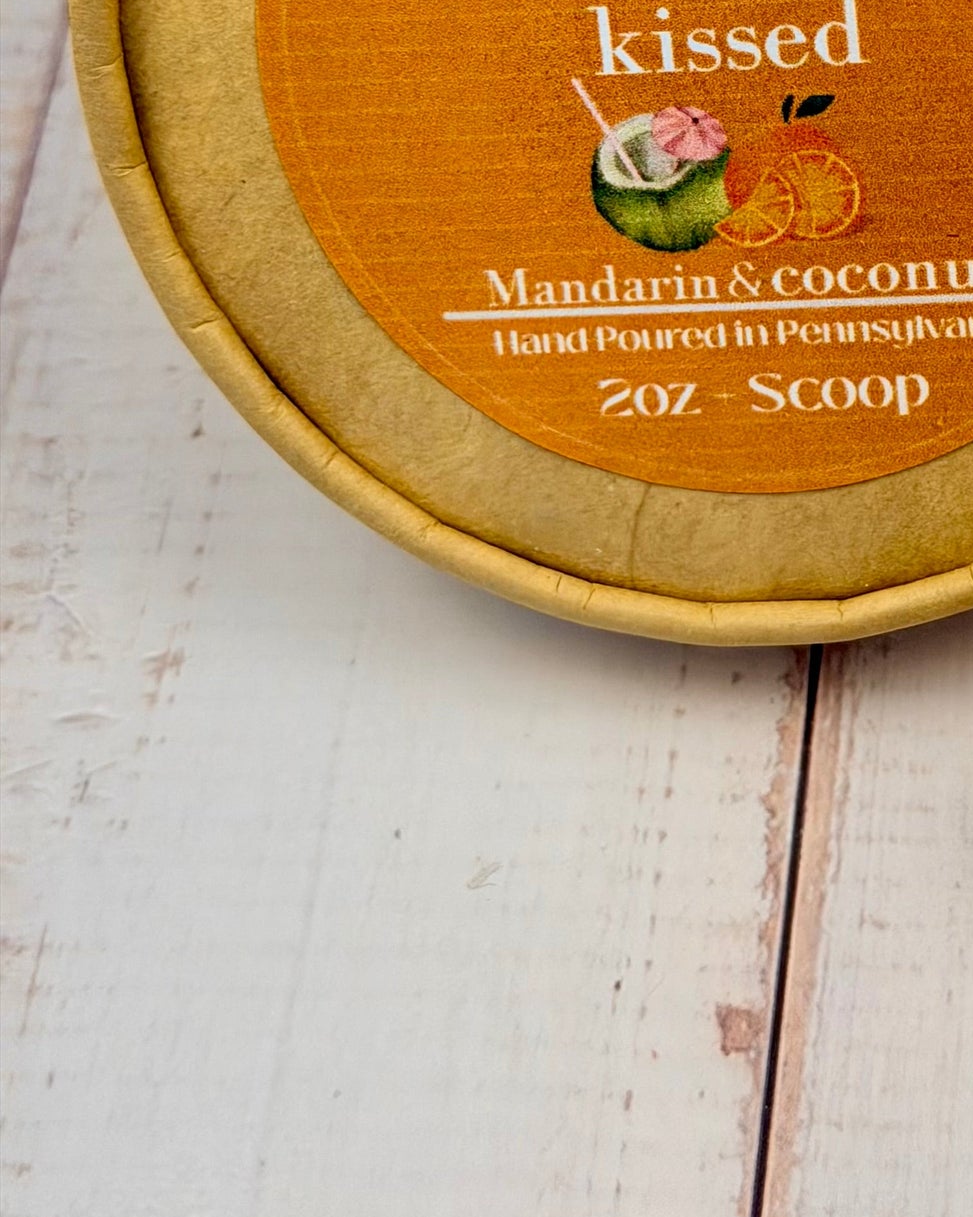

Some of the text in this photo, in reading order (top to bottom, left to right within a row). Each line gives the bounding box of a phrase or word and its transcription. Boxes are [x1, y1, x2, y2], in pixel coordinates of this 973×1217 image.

[484, 264, 718, 309] Mandarin
[727, 260, 763, 297] &
[492, 322, 588, 355] Hand
[594, 321, 728, 351] Poured
[733, 318, 769, 347] in
[748, 372, 930, 416] Scoop
